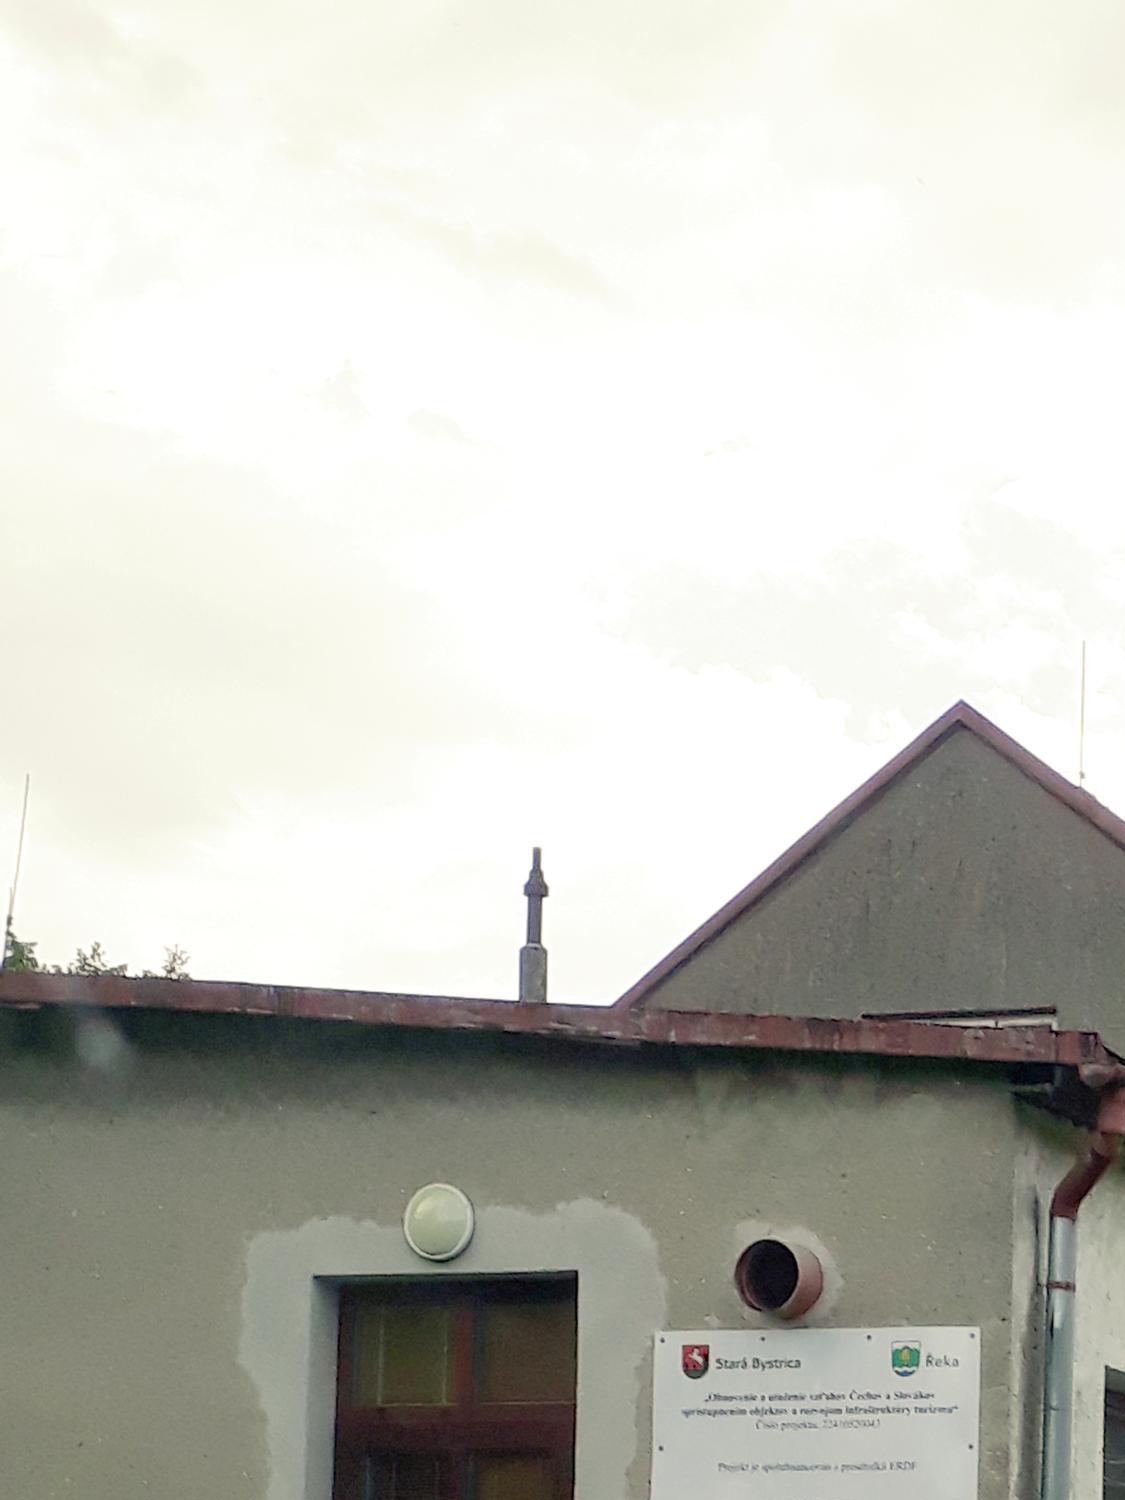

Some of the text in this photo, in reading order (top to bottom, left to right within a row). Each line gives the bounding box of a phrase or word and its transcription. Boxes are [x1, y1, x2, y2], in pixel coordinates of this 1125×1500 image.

[715, 1357, 801, 1371] Stará Bystrica
[925, 1352, 959, 1367] Řeka
